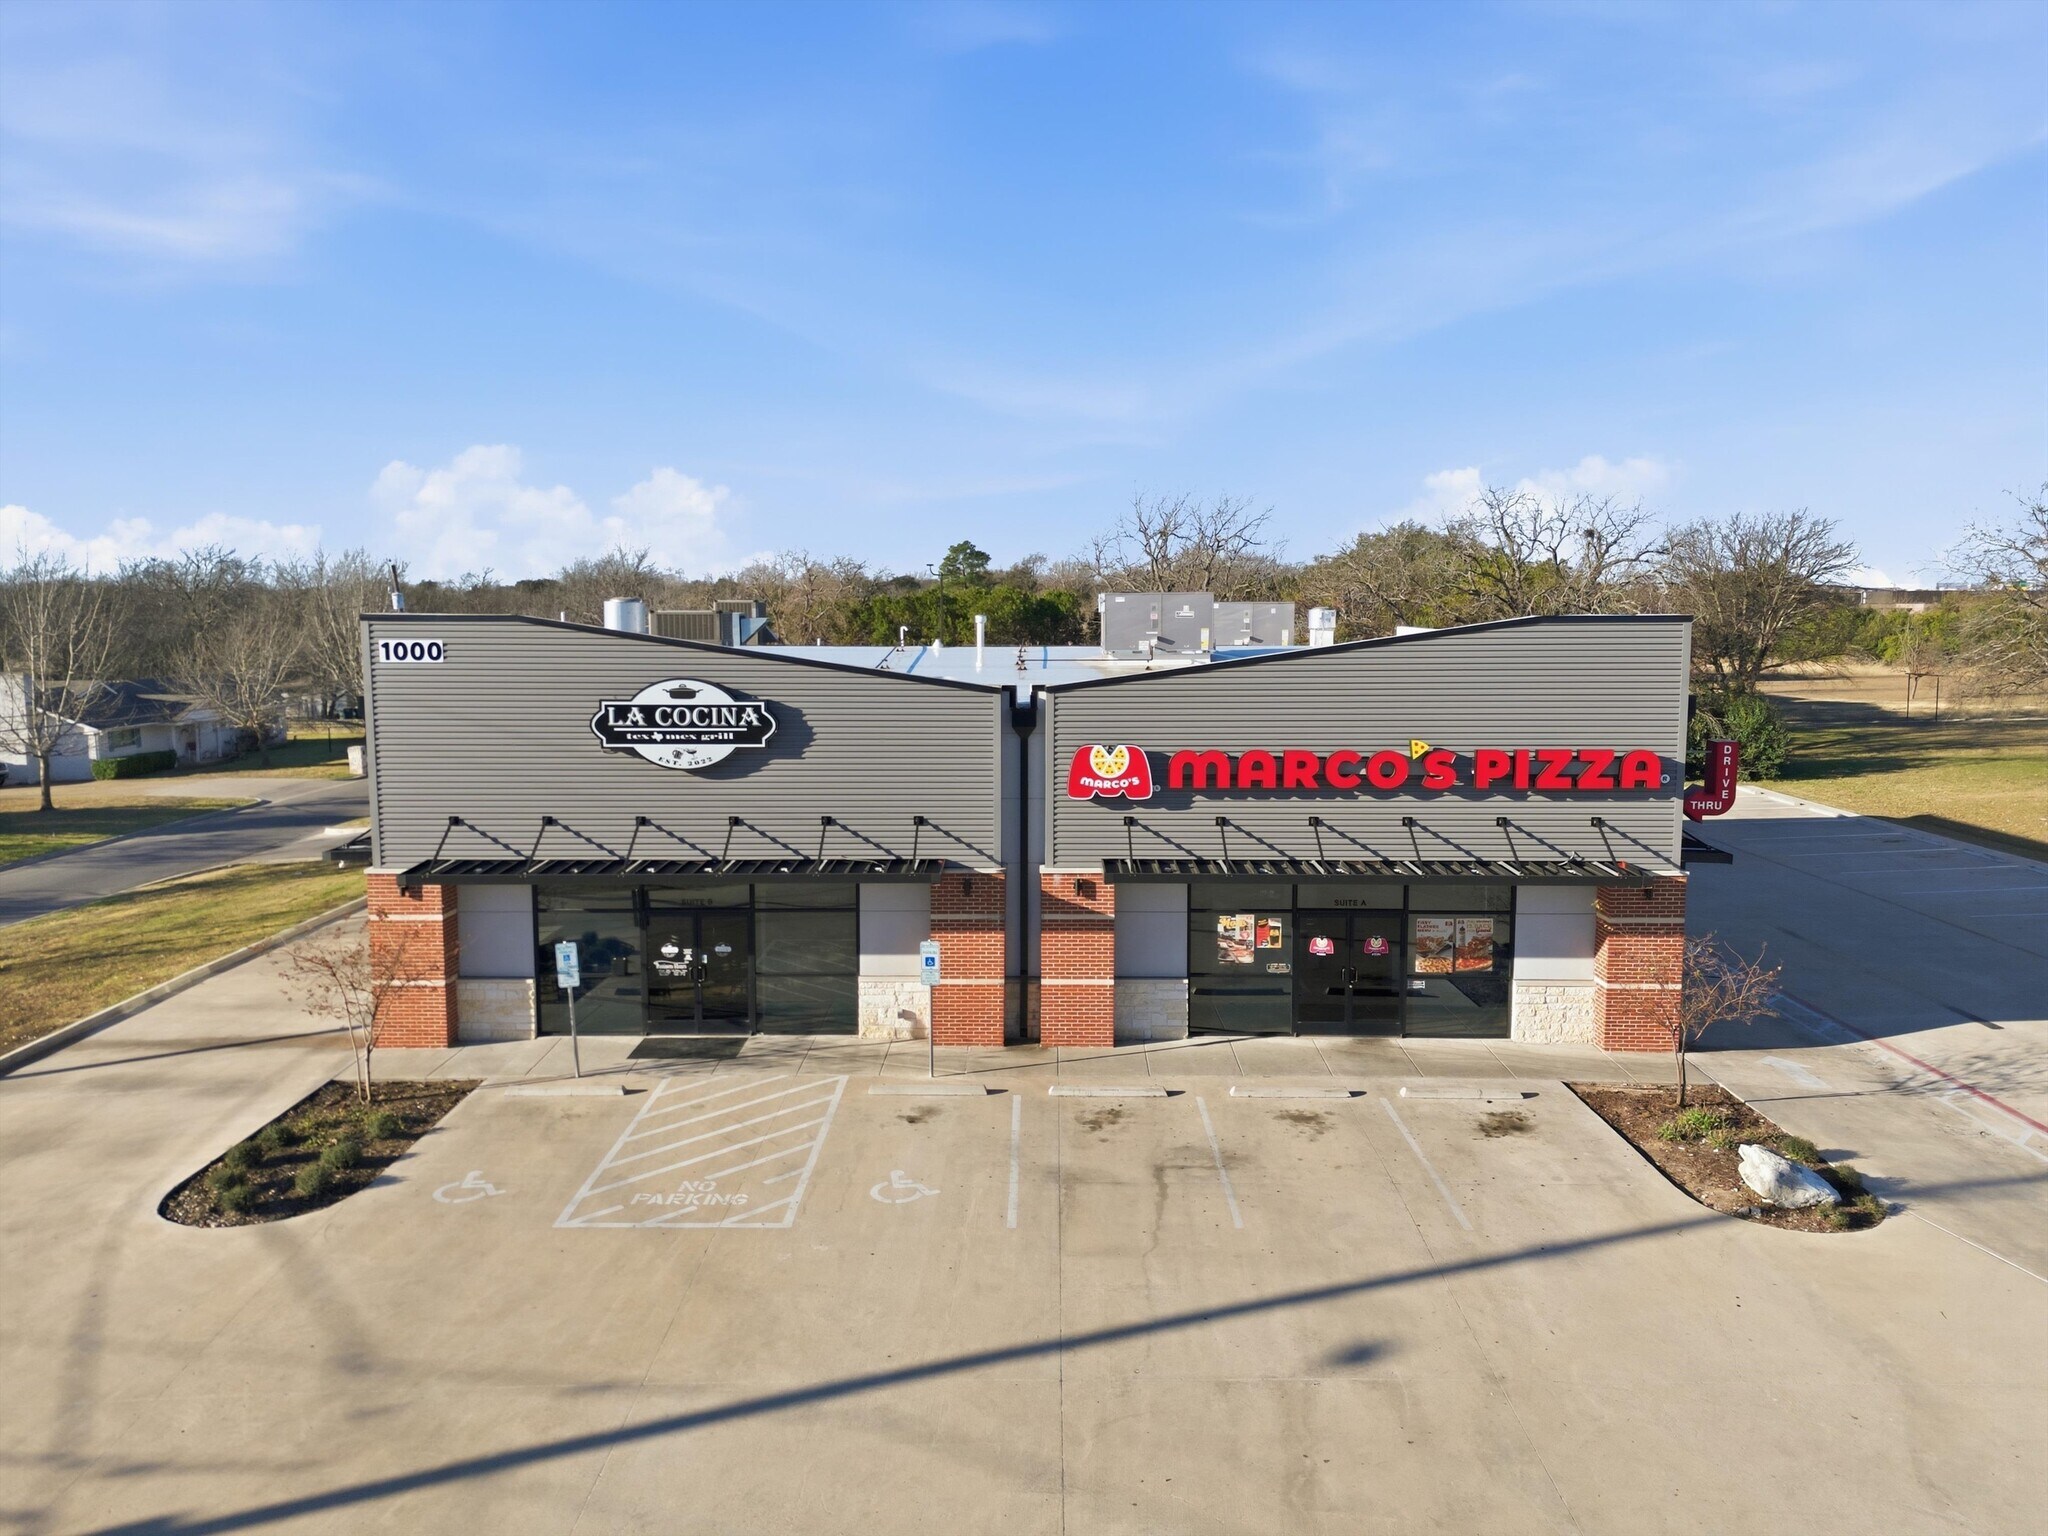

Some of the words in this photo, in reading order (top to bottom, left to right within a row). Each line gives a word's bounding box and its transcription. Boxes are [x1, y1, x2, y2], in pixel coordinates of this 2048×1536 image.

[381, 642, 442, 661] 1000
[607, 706, 648, 727] LA
[655, 706, 761, 727] COCINA
[626, 732, 650, 740] tex
[666, 732, 698, 740] mex
[701, 732, 734, 741] grill
[658, 756, 682, 766] EST.
[687, 756, 713, 767] 2022
[1168, 740, 1457, 789] MARCO'S
[1474, 748, 1662, 789] PIZZA
[1721, 745, 1732, 799] DRIVE
[1080, 776, 1140, 789] MARCO'S
[1690, 801, 1722, 810] THRU
[1334, 899, 1358, 907] SUITE
[1361, 899, 1367, 907] A
[677, 1180, 717, 1192] NO
[630, 1192, 750, 1206] PARKING
